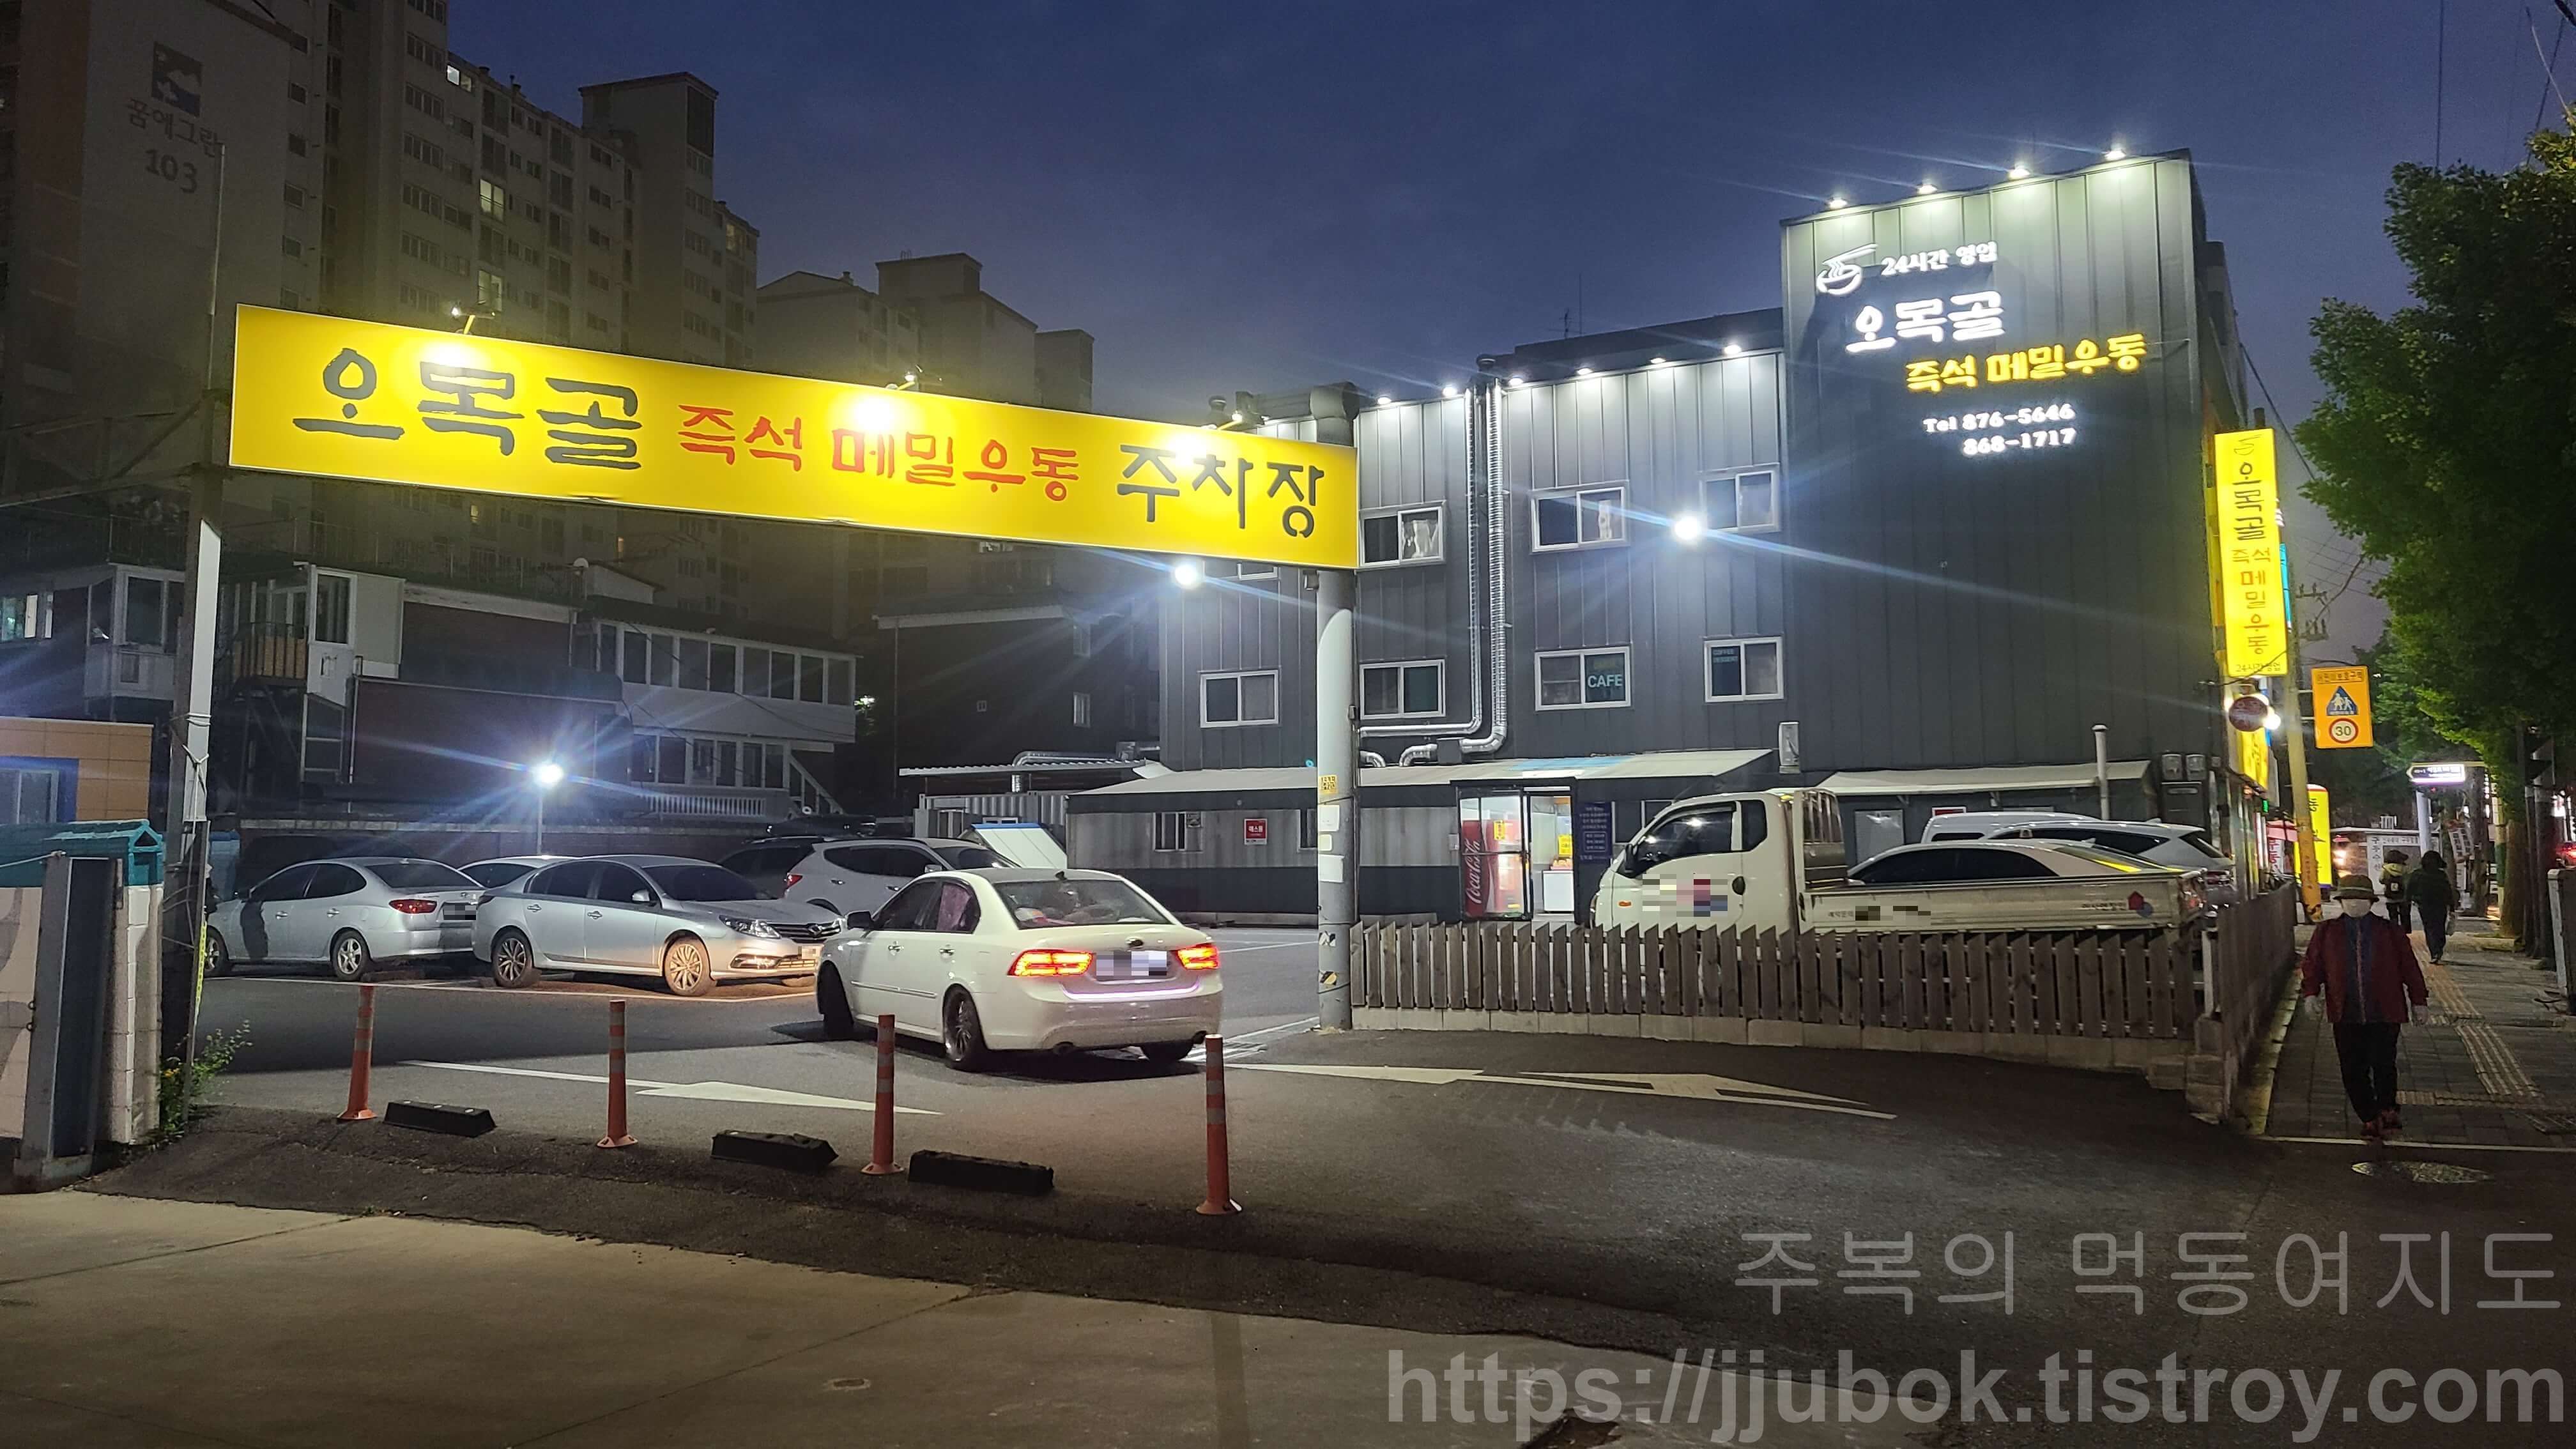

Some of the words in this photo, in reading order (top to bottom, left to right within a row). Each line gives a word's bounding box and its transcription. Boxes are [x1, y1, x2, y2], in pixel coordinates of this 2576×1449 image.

[145, 149, 197, 193] 103
[1881, 249, 1949, 276] 24시간
[1956, 241, 1998, 266] 영업
[1846, 291, 2005, 353] 오목골
[1905, 354, 1979, 392] 즉석
[1986, 334, 2147, 382] 메밀우동
[1923, 416, 1958, 433] Tel
[1962, 403, 2076, 431] 876-5646
[292, 348, 642, 470] 오목골
[677, 404, 802, 471] 즉석
[832, 428, 1080, 501] 메밀우동
[1116, 443, 1325, 537] 주차장
[1963, 427, 2077, 456] 868-1717
[2232, 462, 2267, 540] 오목골
[2232, 548, 2271, 563] 즉석
[1587, 674, 1623, 688] CAFE
[2335, 725, 2352, 737] 30
